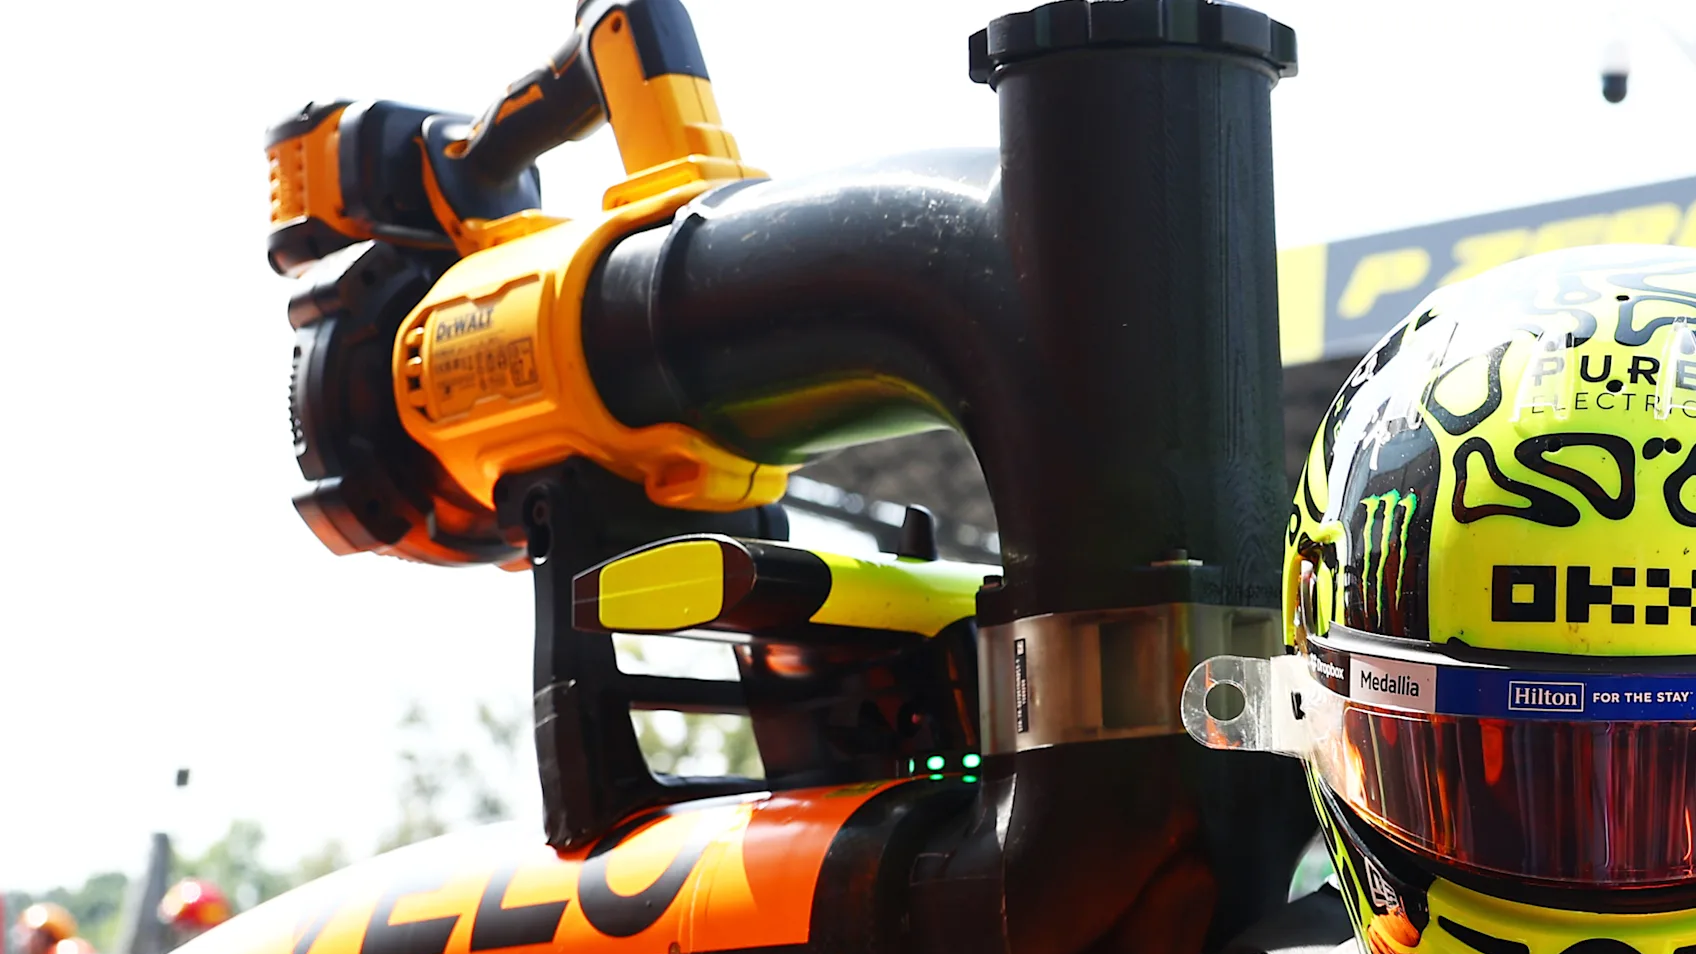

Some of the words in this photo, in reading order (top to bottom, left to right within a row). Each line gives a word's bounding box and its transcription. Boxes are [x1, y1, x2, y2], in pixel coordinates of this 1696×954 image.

[1336, 248, 1430, 320] P
[1360, 670, 1420, 697] Medallia
[1515, 687, 1577, 706] Hilton
[1593, 692, 1620, 703] FOR
[1624, 692, 1652, 703] THE
[1656, 691, 1690, 703] STAY
